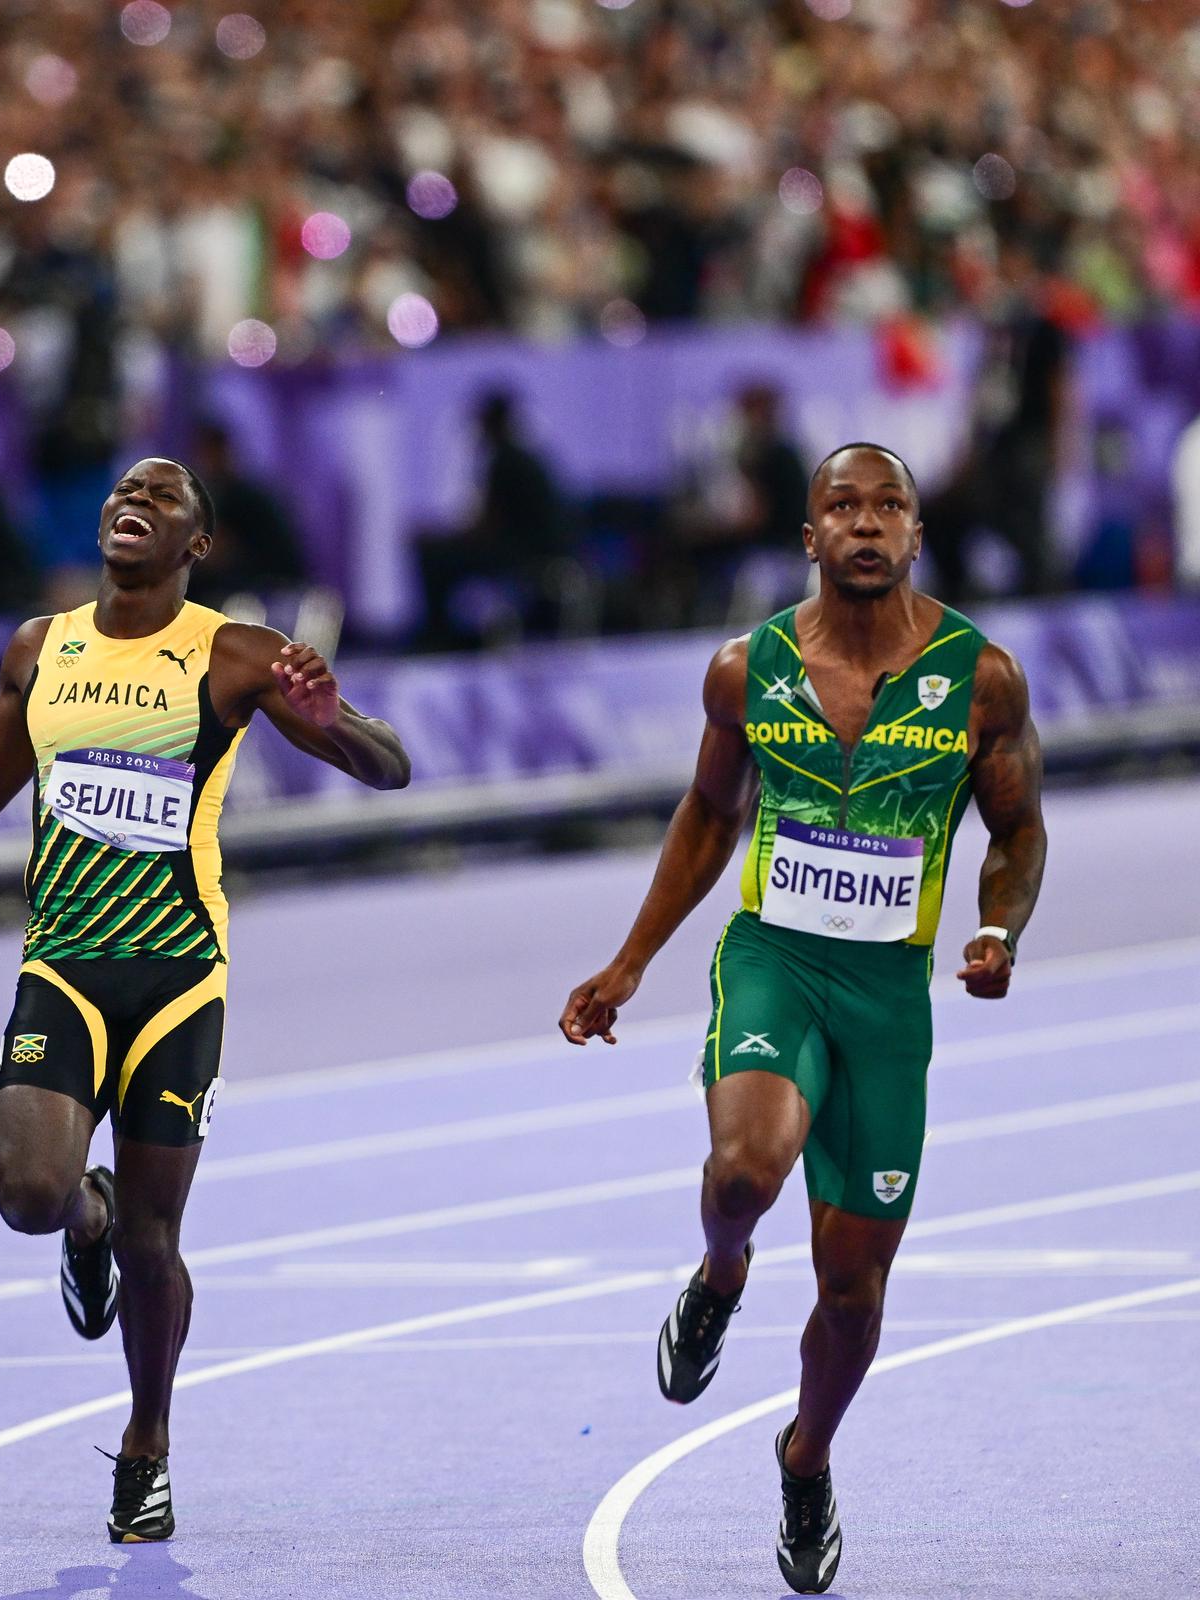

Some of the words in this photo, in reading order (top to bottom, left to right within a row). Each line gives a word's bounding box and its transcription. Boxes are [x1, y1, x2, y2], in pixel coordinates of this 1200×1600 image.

[49, 682, 168, 711] JAMAICA
[745, 722, 828, 744] SOUTH
[863, 723, 969, 753] AFRICA
[88, 751, 122, 764] PARIS
[126, 756, 159, 770] 2024
[56, 781, 180, 828] SEVILLE
[810, 830, 849, 845] PARIS
[853, 837, 889, 852] 2024
[771, 856, 915, 907] SIMBINE
